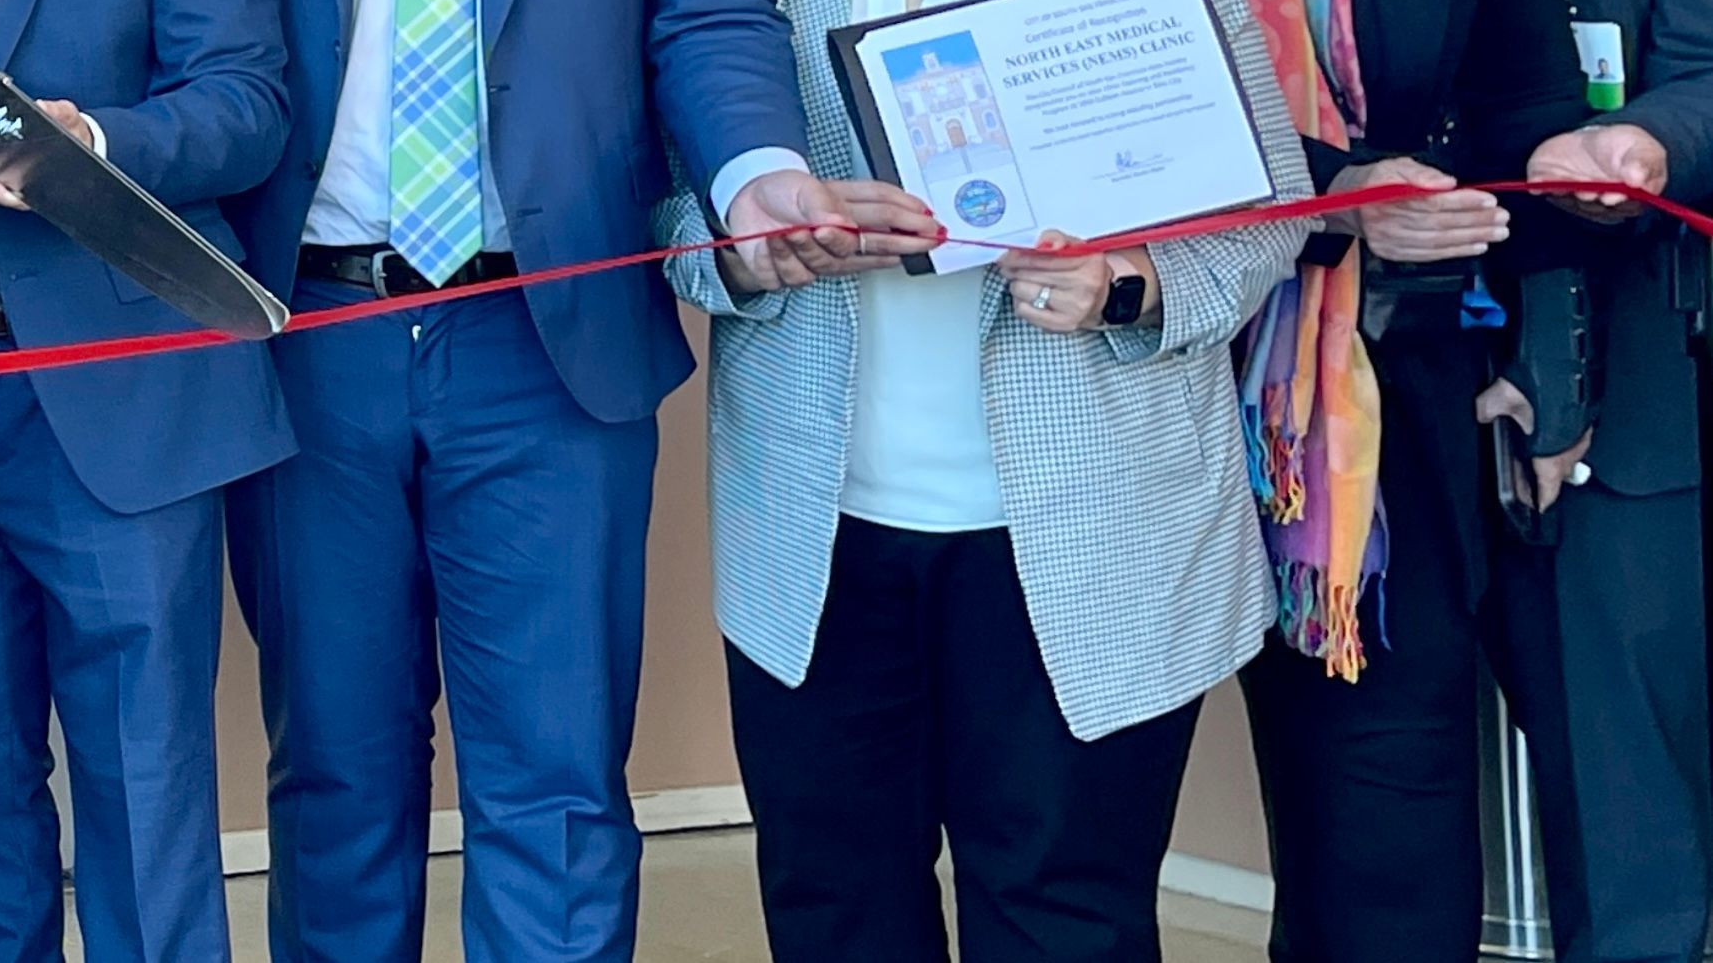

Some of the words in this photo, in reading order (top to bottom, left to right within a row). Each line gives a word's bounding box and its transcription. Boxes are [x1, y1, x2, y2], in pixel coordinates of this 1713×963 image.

[1002, 60, 1080, 89] SERVICES
[1082, 45, 1138, 71] (NEMS)
[1139, 31, 1196, 56] CLINIC
[1005, 44, 1062, 70] NORTH
[1065, 33, 1104, 59] EAST
[1106, 16, 1182, 46] MEDICAL
